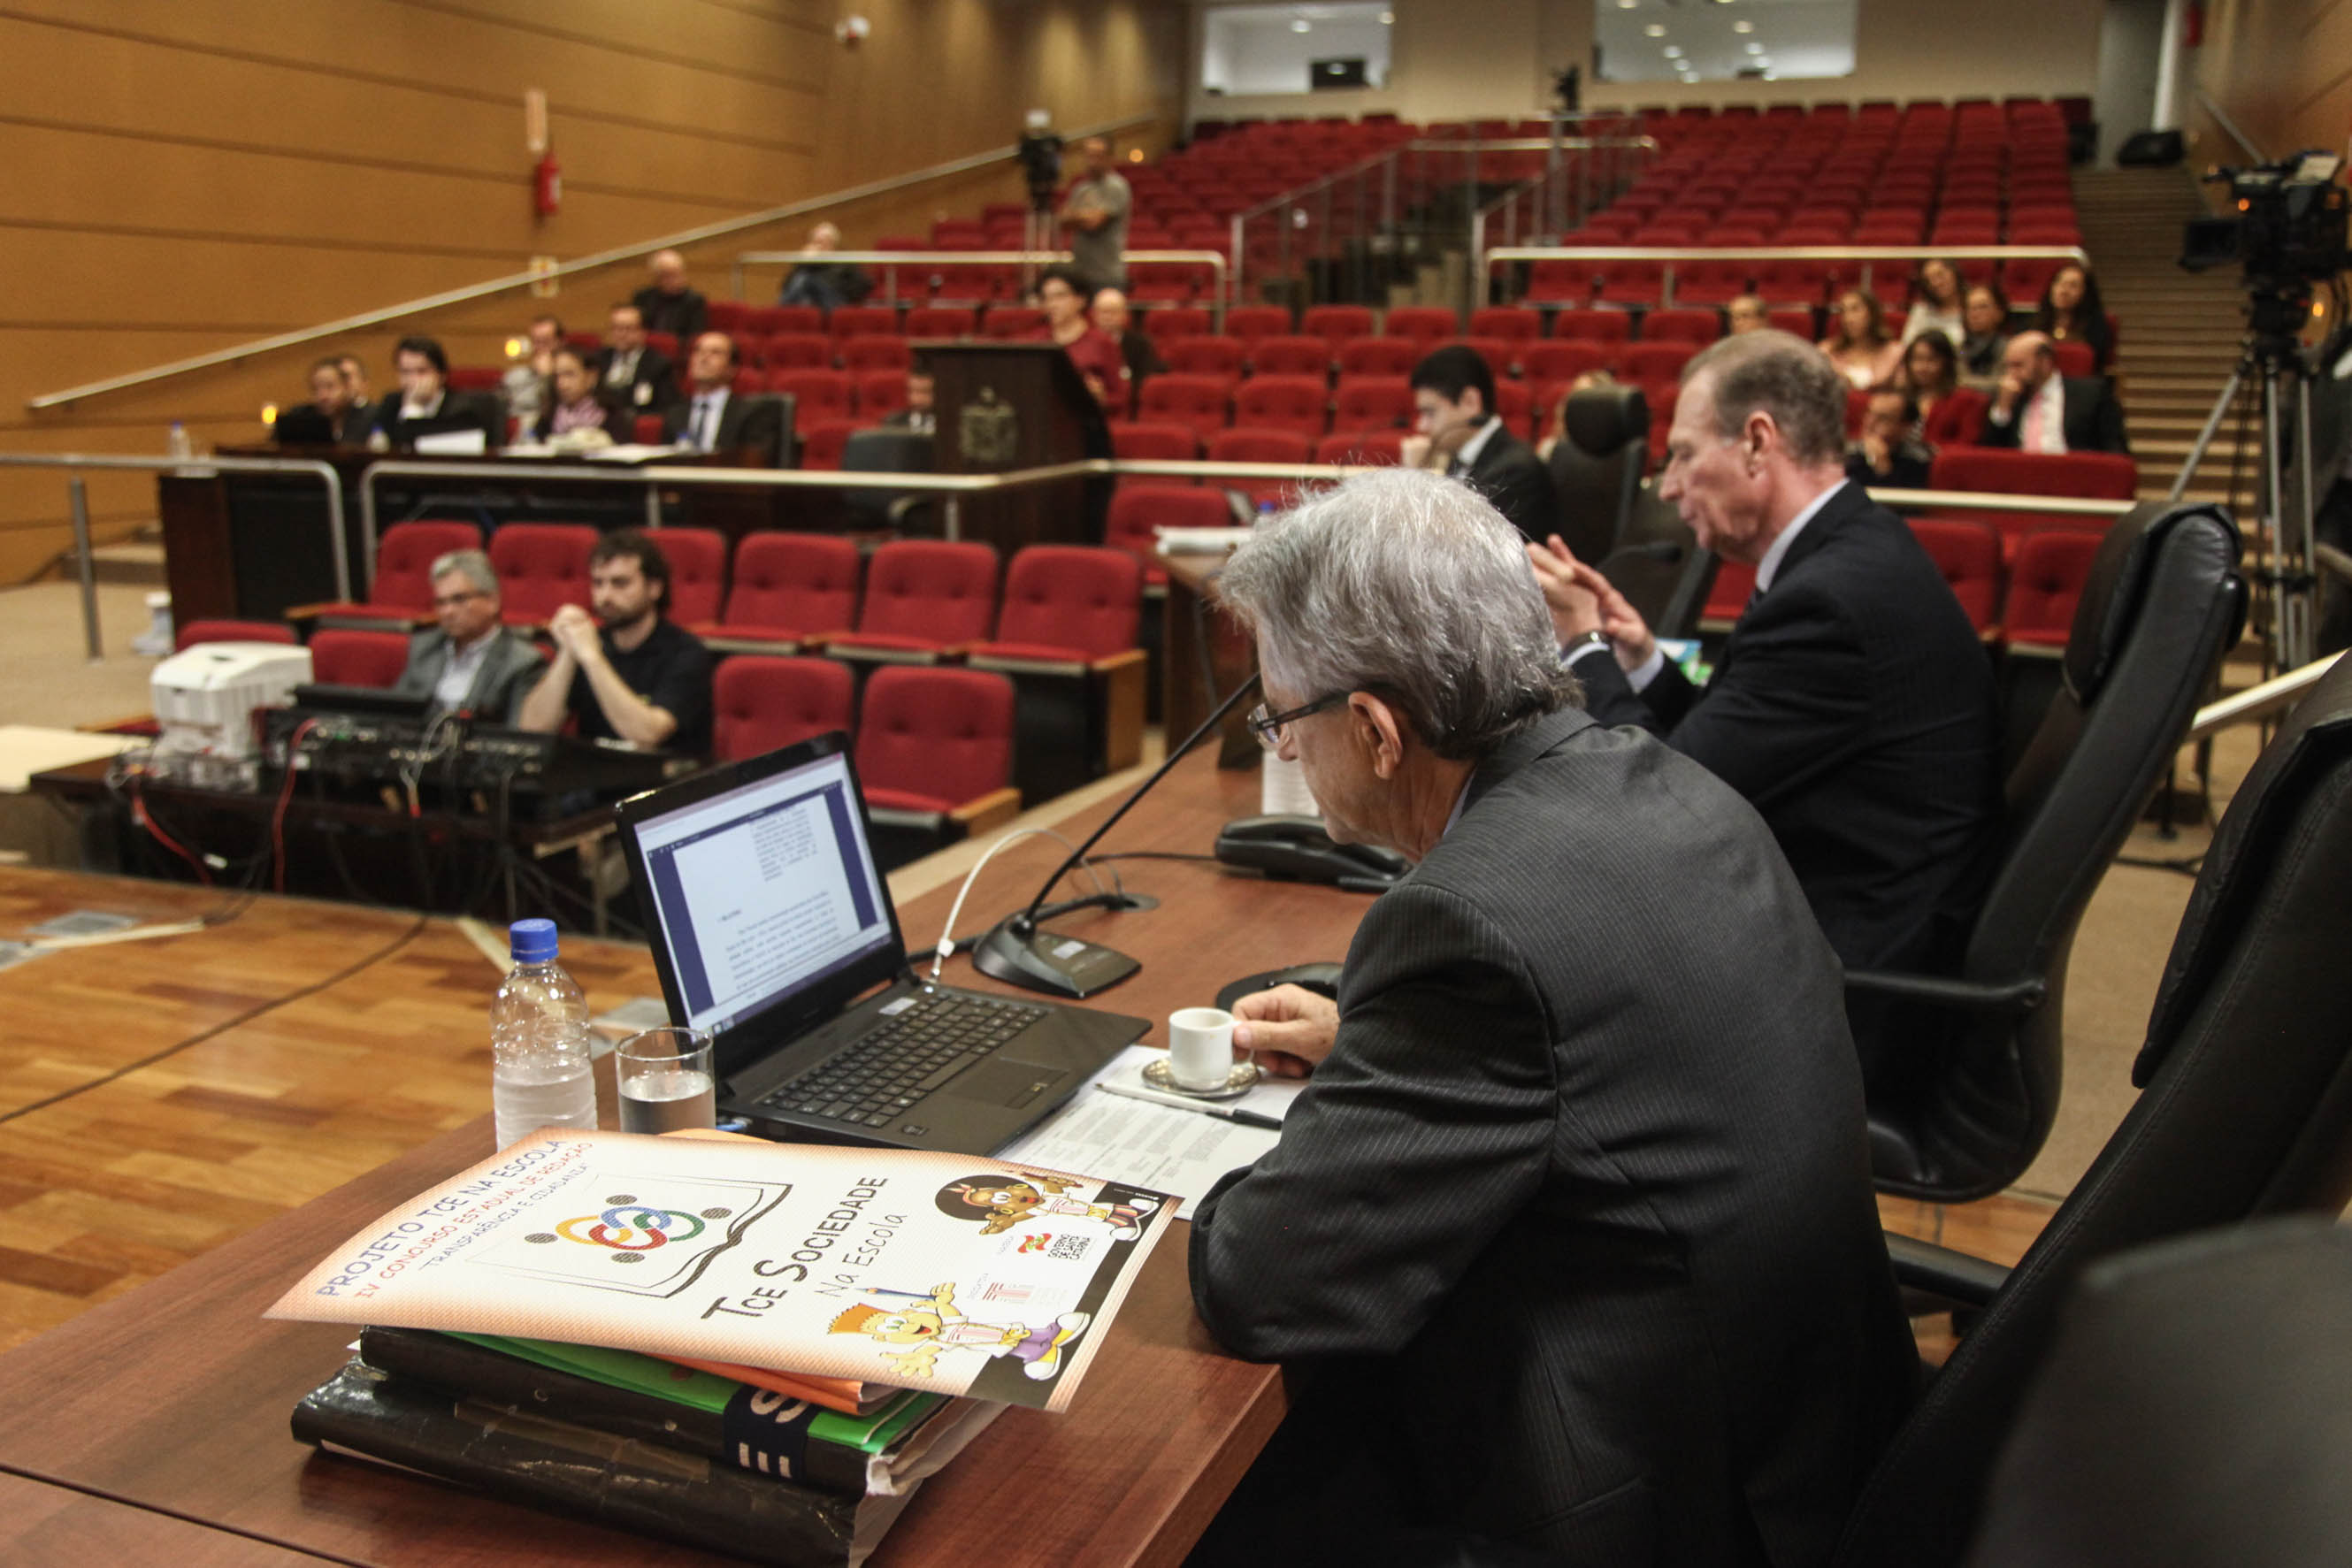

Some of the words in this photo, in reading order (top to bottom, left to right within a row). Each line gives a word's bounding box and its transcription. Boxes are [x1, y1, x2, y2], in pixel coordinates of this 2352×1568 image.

[315, 1221, 425, 1296] PROJETO
[416, 1196, 470, 1217] TCE
[460, 1180, 496, 1197] NA
[490, 1140, 567, 1179] ESCOLA
[354, 1283, 381, 1298] IV
[379, 1225, 458, 1279] CONCURSO
[452, 1188, 525, 1225] ESTADUAL
[517, 1174, 544, 1186] DE
[536, 1143, 593, 1175] REDAÇÃO
[814, 1274, 860, 1297] Na
[842, 1212, 908, 1266] Escola
